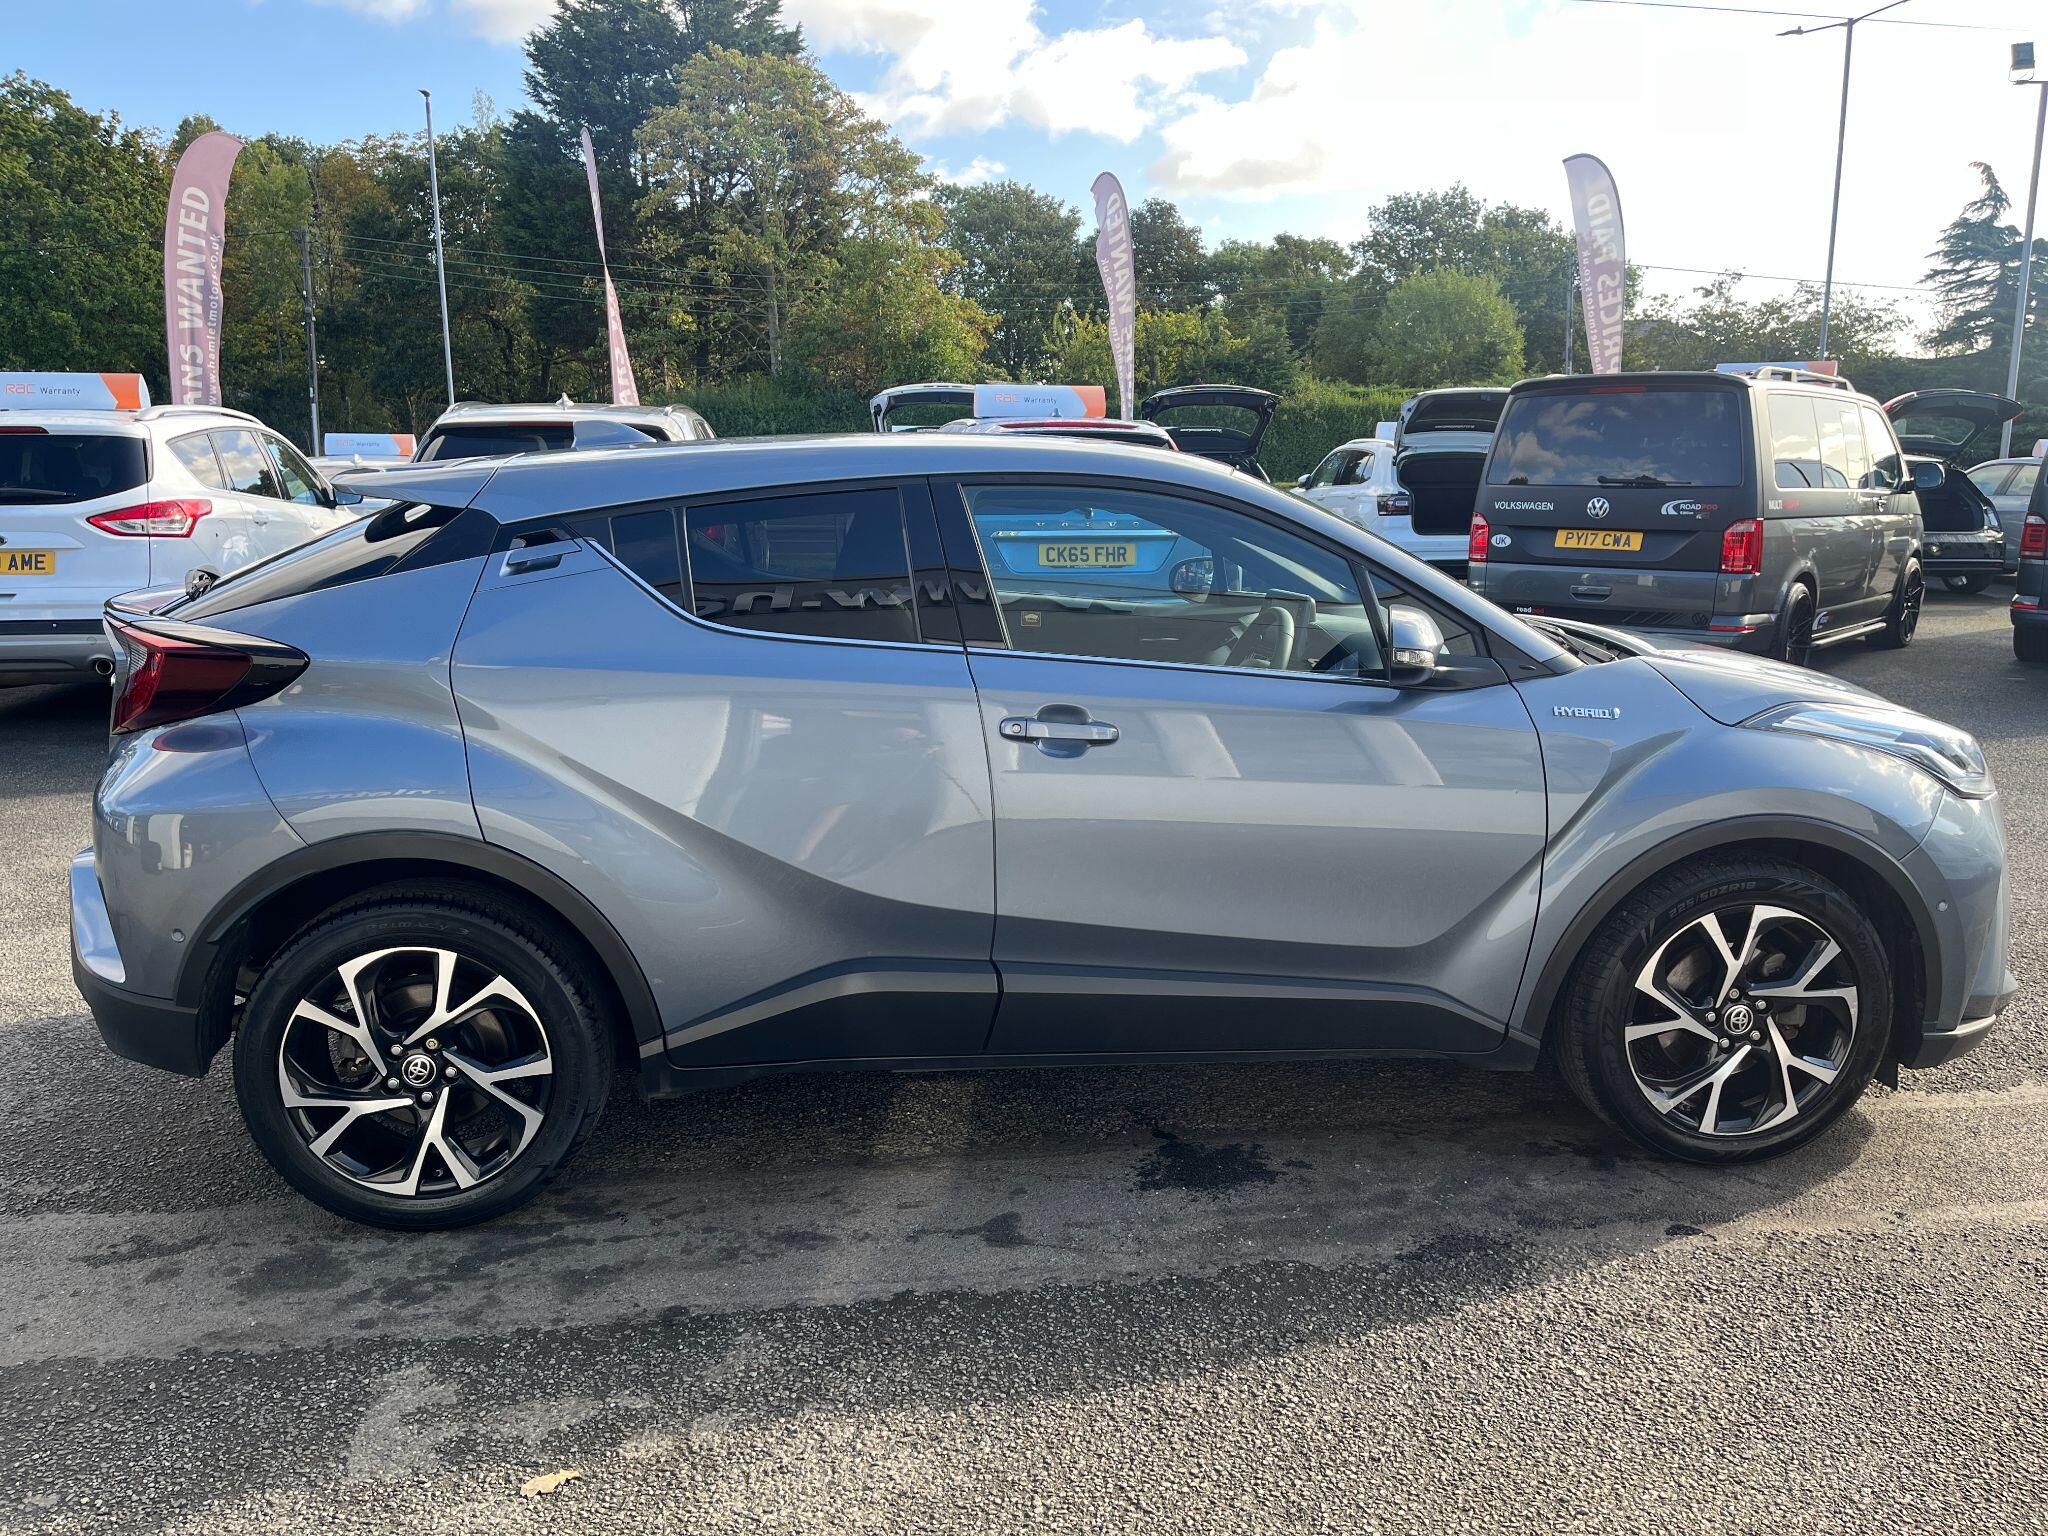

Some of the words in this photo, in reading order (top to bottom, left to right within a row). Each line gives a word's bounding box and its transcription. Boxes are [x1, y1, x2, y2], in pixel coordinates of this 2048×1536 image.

[176, 186, 210, 329] WANTED
[208, 233, 222, 405] www.hamletmotors.co.uk
[40, 387, 80, 396] Warranty
[1024, 397, 1058, 405] Warranty
[1494, 501, 1554, 511] VOLKSWAGEN
[1495, 536, 1507, 545] UK
[1564, 531, 1598, 546] PY17
[1602, 533, 1631, 548] CWA
[8, 553, 46, 571] AME
[1045, 546, 1090, 563] CK65
[1094, 547, 1127, 563] FHR
[1553, 706, 1610, 719] HYBRID
